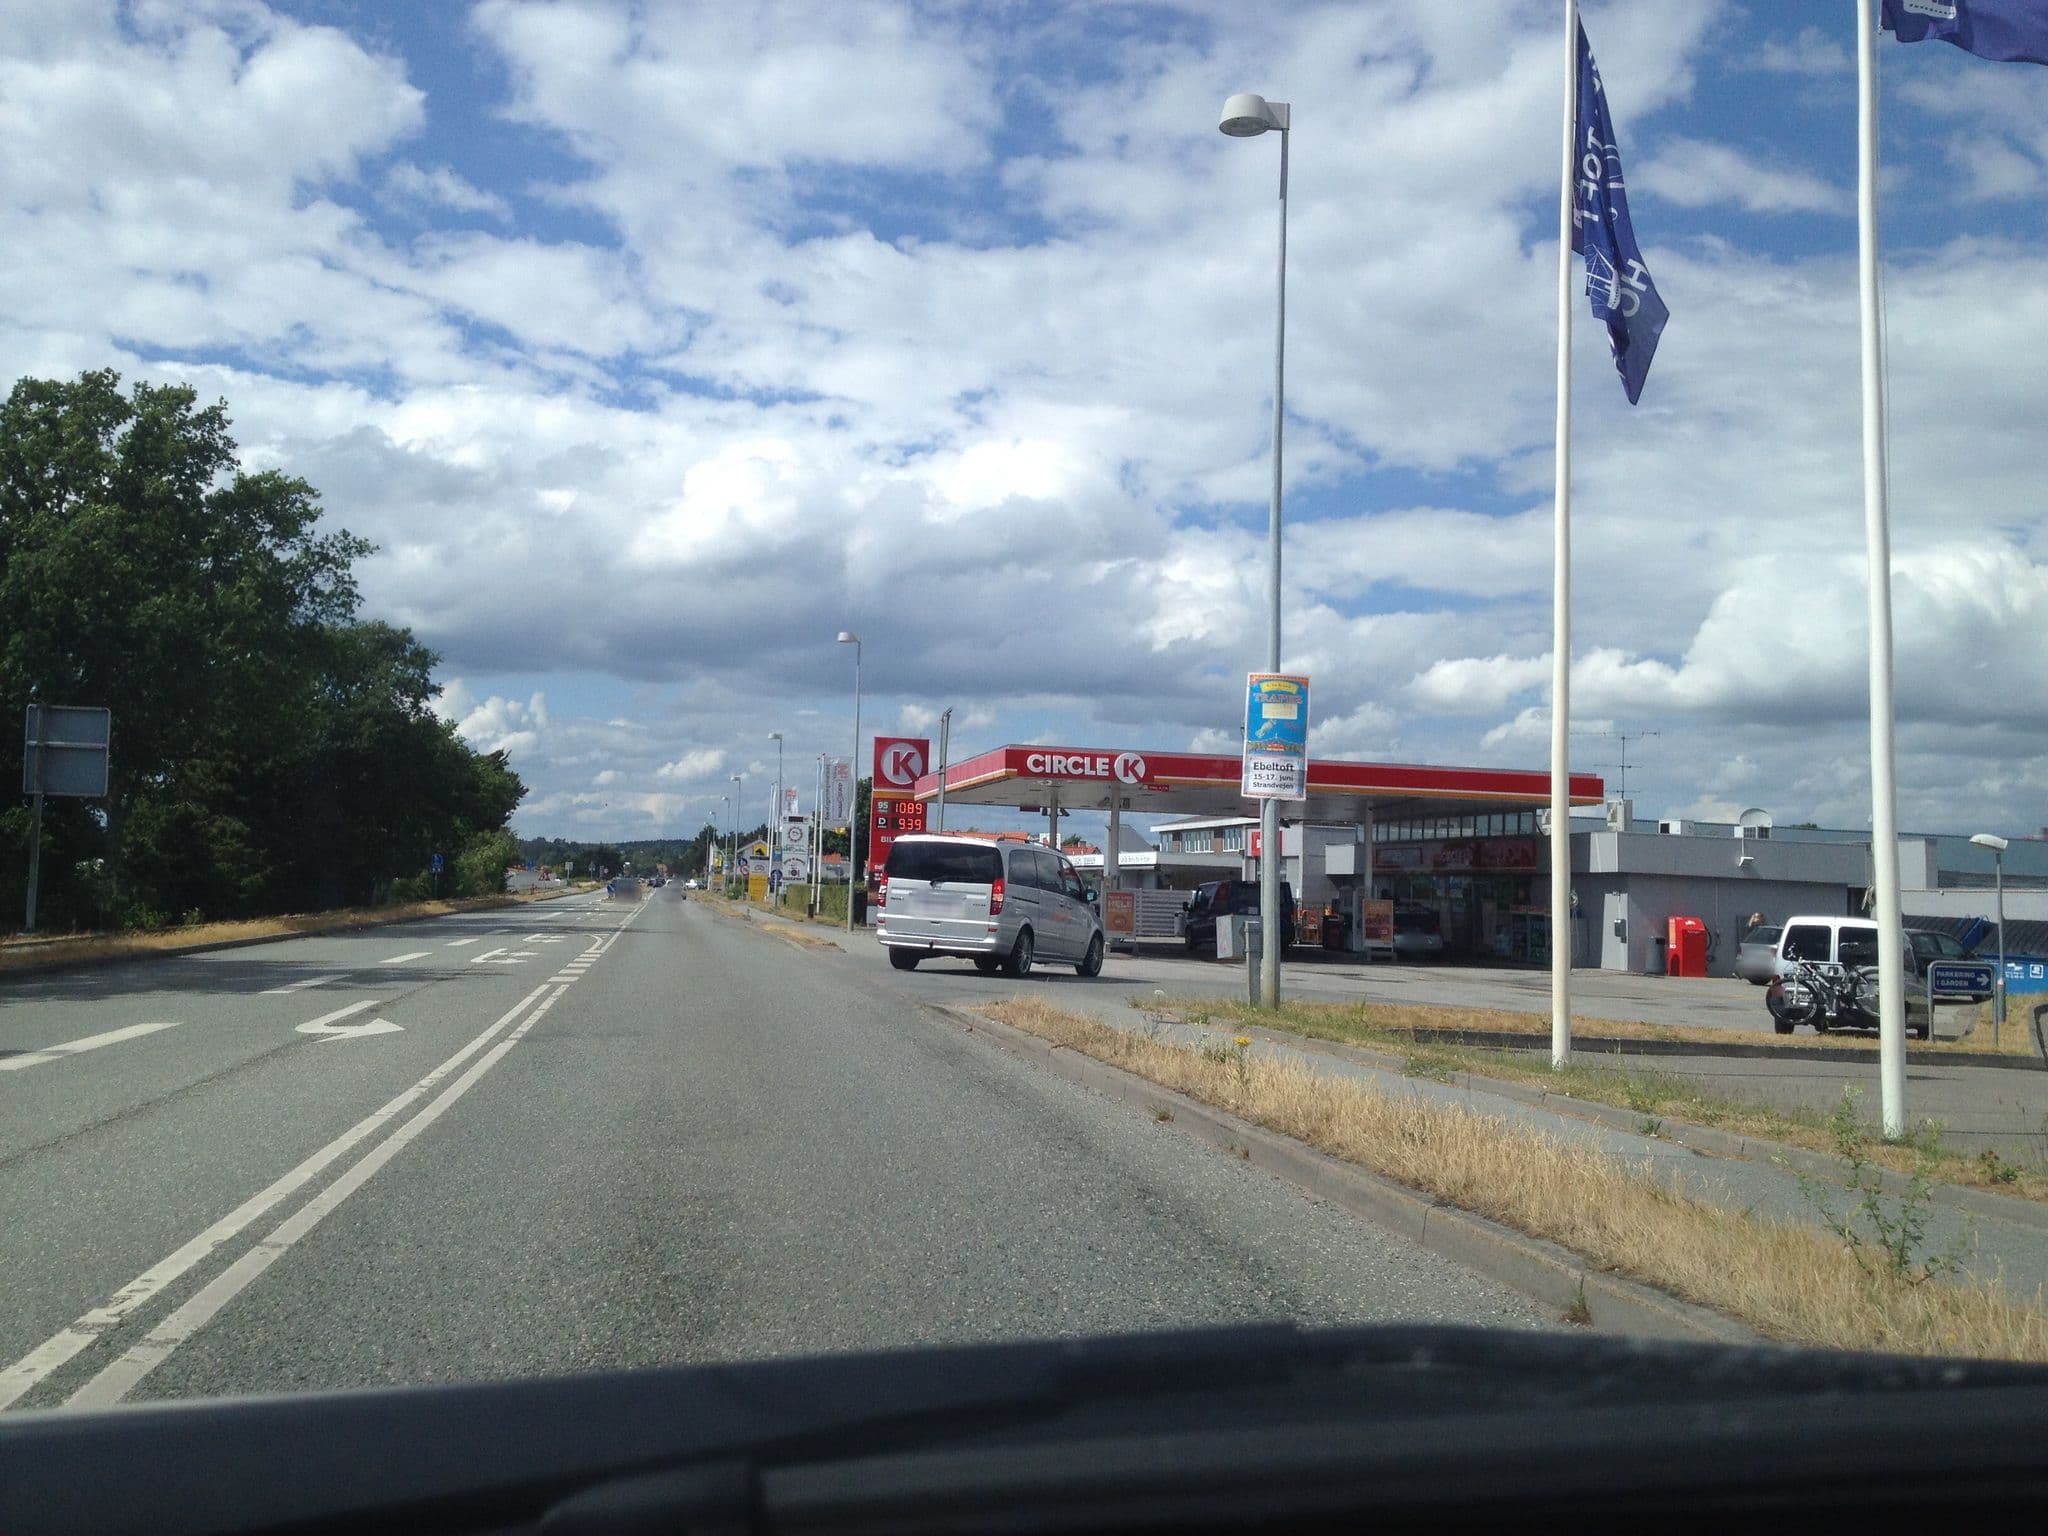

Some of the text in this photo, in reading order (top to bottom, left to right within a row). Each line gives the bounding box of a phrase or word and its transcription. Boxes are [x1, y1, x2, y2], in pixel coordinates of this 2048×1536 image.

[891, 750, 921, 783] K
[1026, 753, 1110, 776] CIRCLE
[1253, 762, 1295, 771] Ebeltoft
[1253, 781, 1294, 790] Strandvejen
[877, 801, 889, 809] 95
[878, 817, 922, 831] D 939
[1936, 970, 1976, 978] PARKERING
